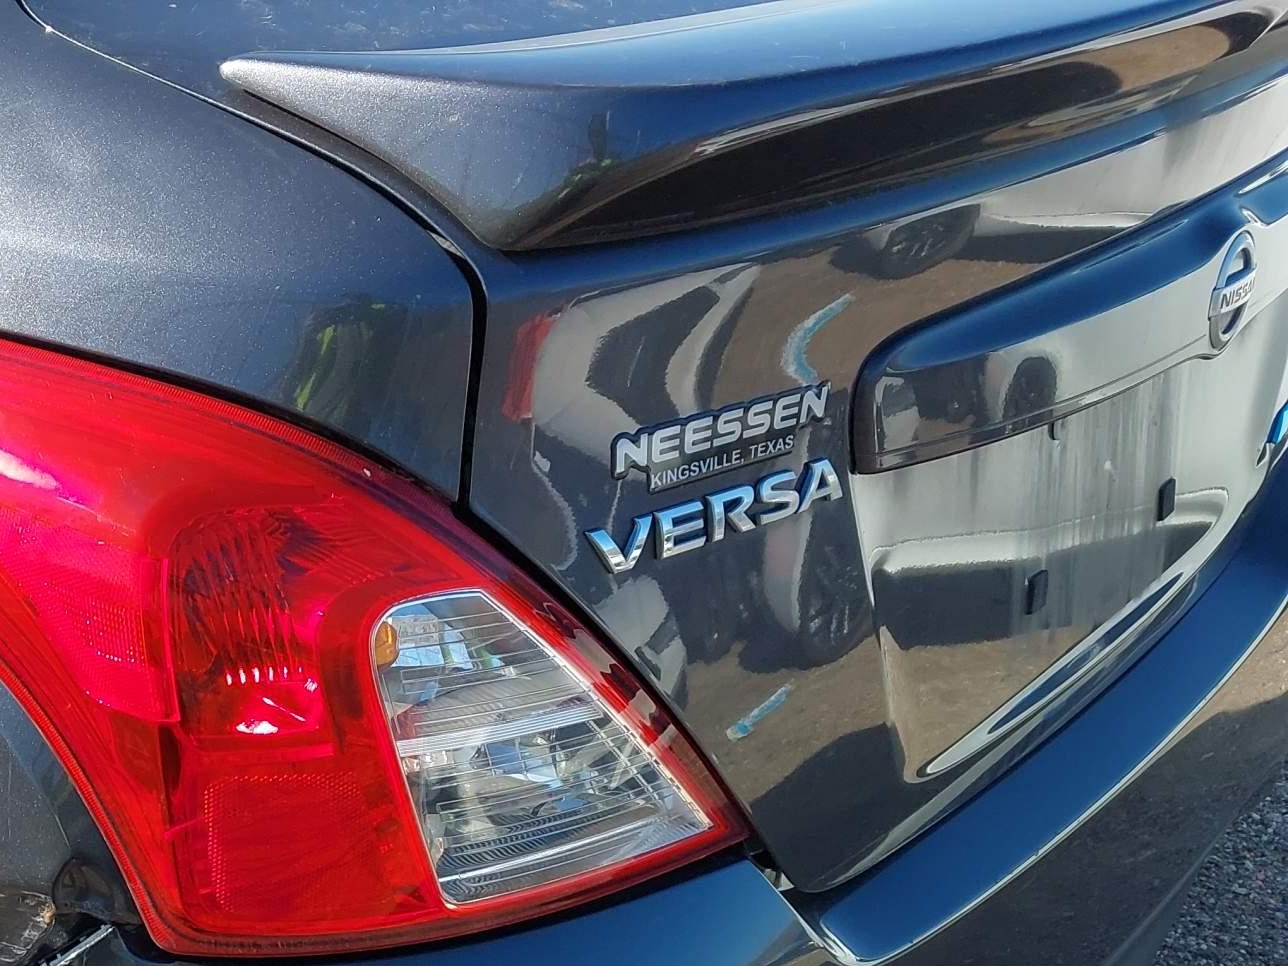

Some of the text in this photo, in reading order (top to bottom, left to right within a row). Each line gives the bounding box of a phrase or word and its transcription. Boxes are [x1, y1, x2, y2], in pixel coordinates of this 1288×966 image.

[615, 385, 830, 475] NEESSEN
[650, 434, 796, 489] KINGSVILLE, TEXAS
[585, 458, 843, 574] VERSA
